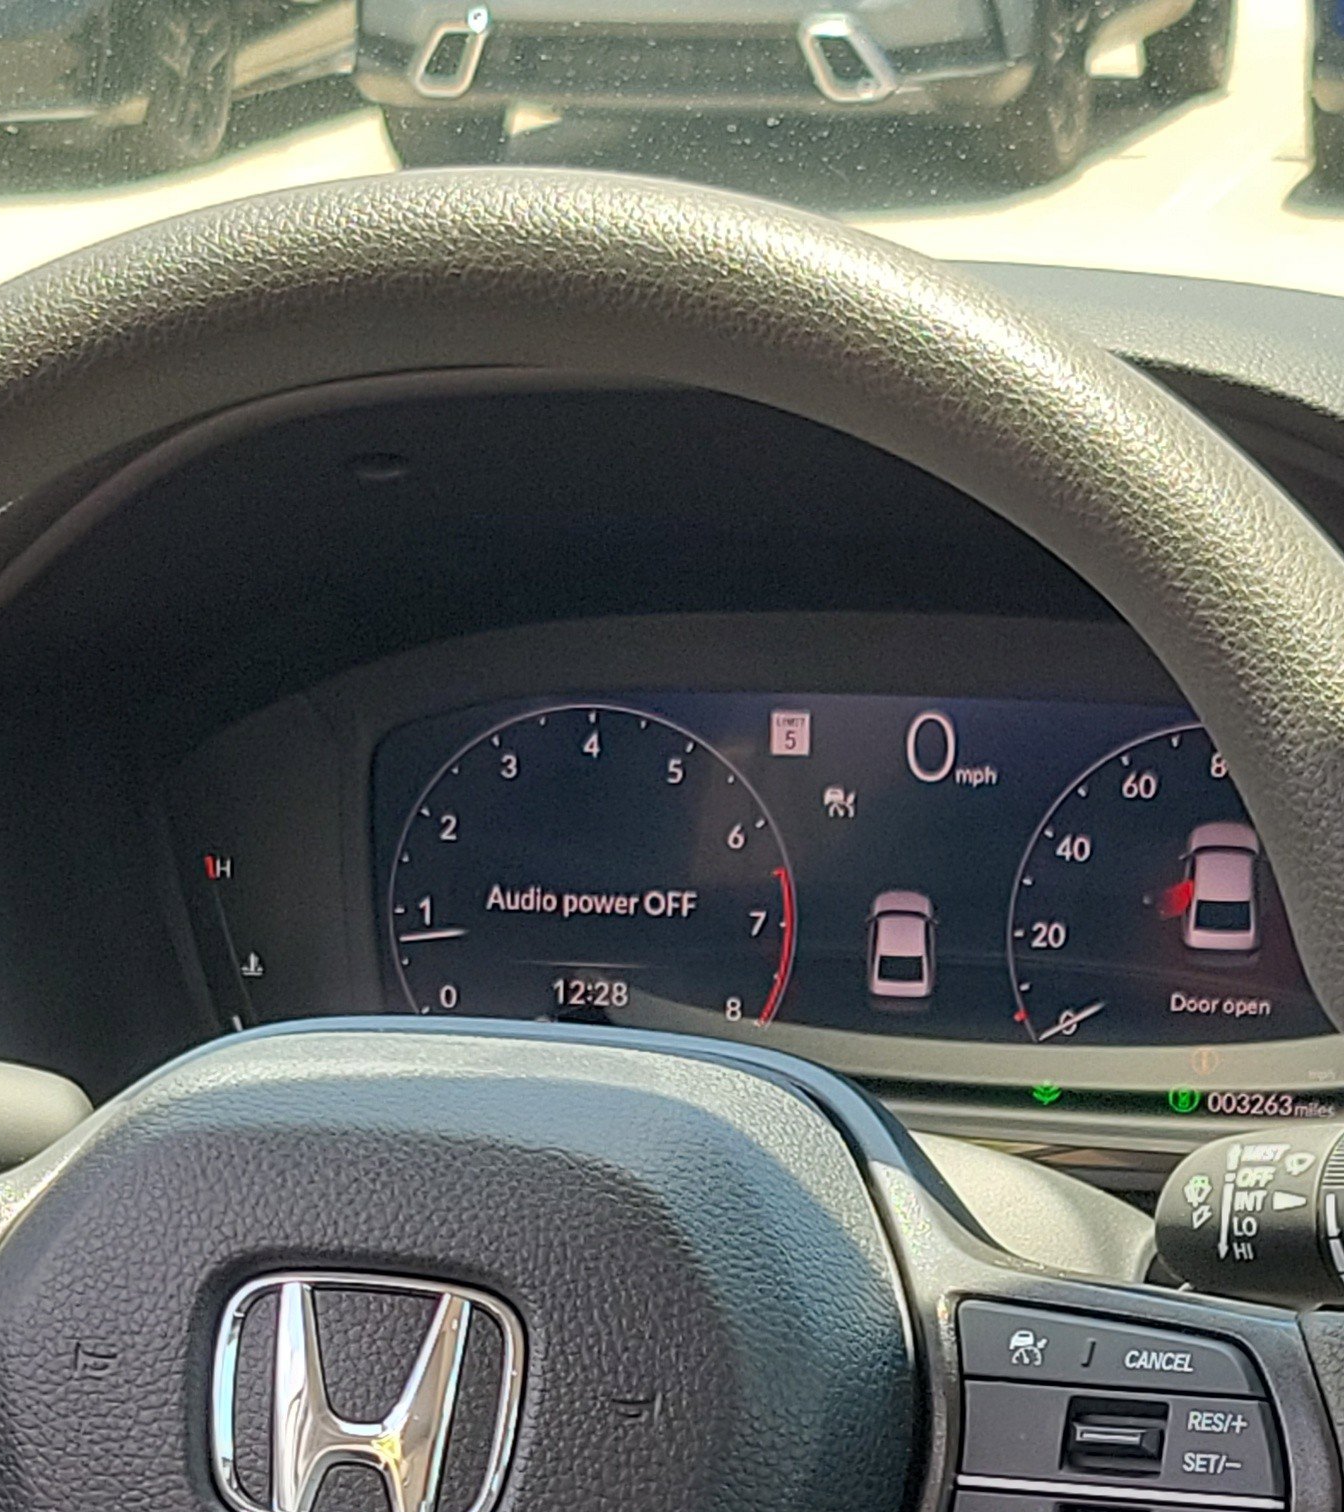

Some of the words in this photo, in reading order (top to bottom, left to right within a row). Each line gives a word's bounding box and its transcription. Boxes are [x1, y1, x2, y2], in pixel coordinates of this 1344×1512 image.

[583, 734, 600, 757] 4
[785, 730, 796, 750] 5
[907, 711, 955, 782] 0
[956, 767, 997, 787] mph
[501, 756, 518, 780] 3
[667, 760, 684, 784] 5
[1211, 751, 1227, 778] 8
[1122, 774, 1157, 799] 60
[440, 816, 457, 840] 2
[727, 826, 745, 849] 6
[1056, 837, 1091, 862] 40
[420, 900, 432, 924] 1
[486, 886, 557, 914] Audio
[563, 894, 638, 918] power
[644, 892, 697, 917] OFF
[750, 913, 766, 936] 7
[1031, 922, 1066, 948] 20
[440, 986, 456, 1008] 0
[553, 981, 628, 1008] 12:28
[1171, 994, 1218, 1014] Door
[1223, 996, 1271, 1017] open
[725, 1000, 742, 1022] 8
[1207, 1091, 1293, 1116] 003263
[1294, 1101, 1336, 1119] miles
[1235, 1166, 1276, 1187] OFF
[1234, 1190, 1268, 1211] INT
[1233, 1216, 1257, 1236] LO
[1233, 1242, 1254, 1260] HI
[1125, 1350, 1194, 1373] CANCEL
[1187, 1411, 1248, 1434] RES/+
